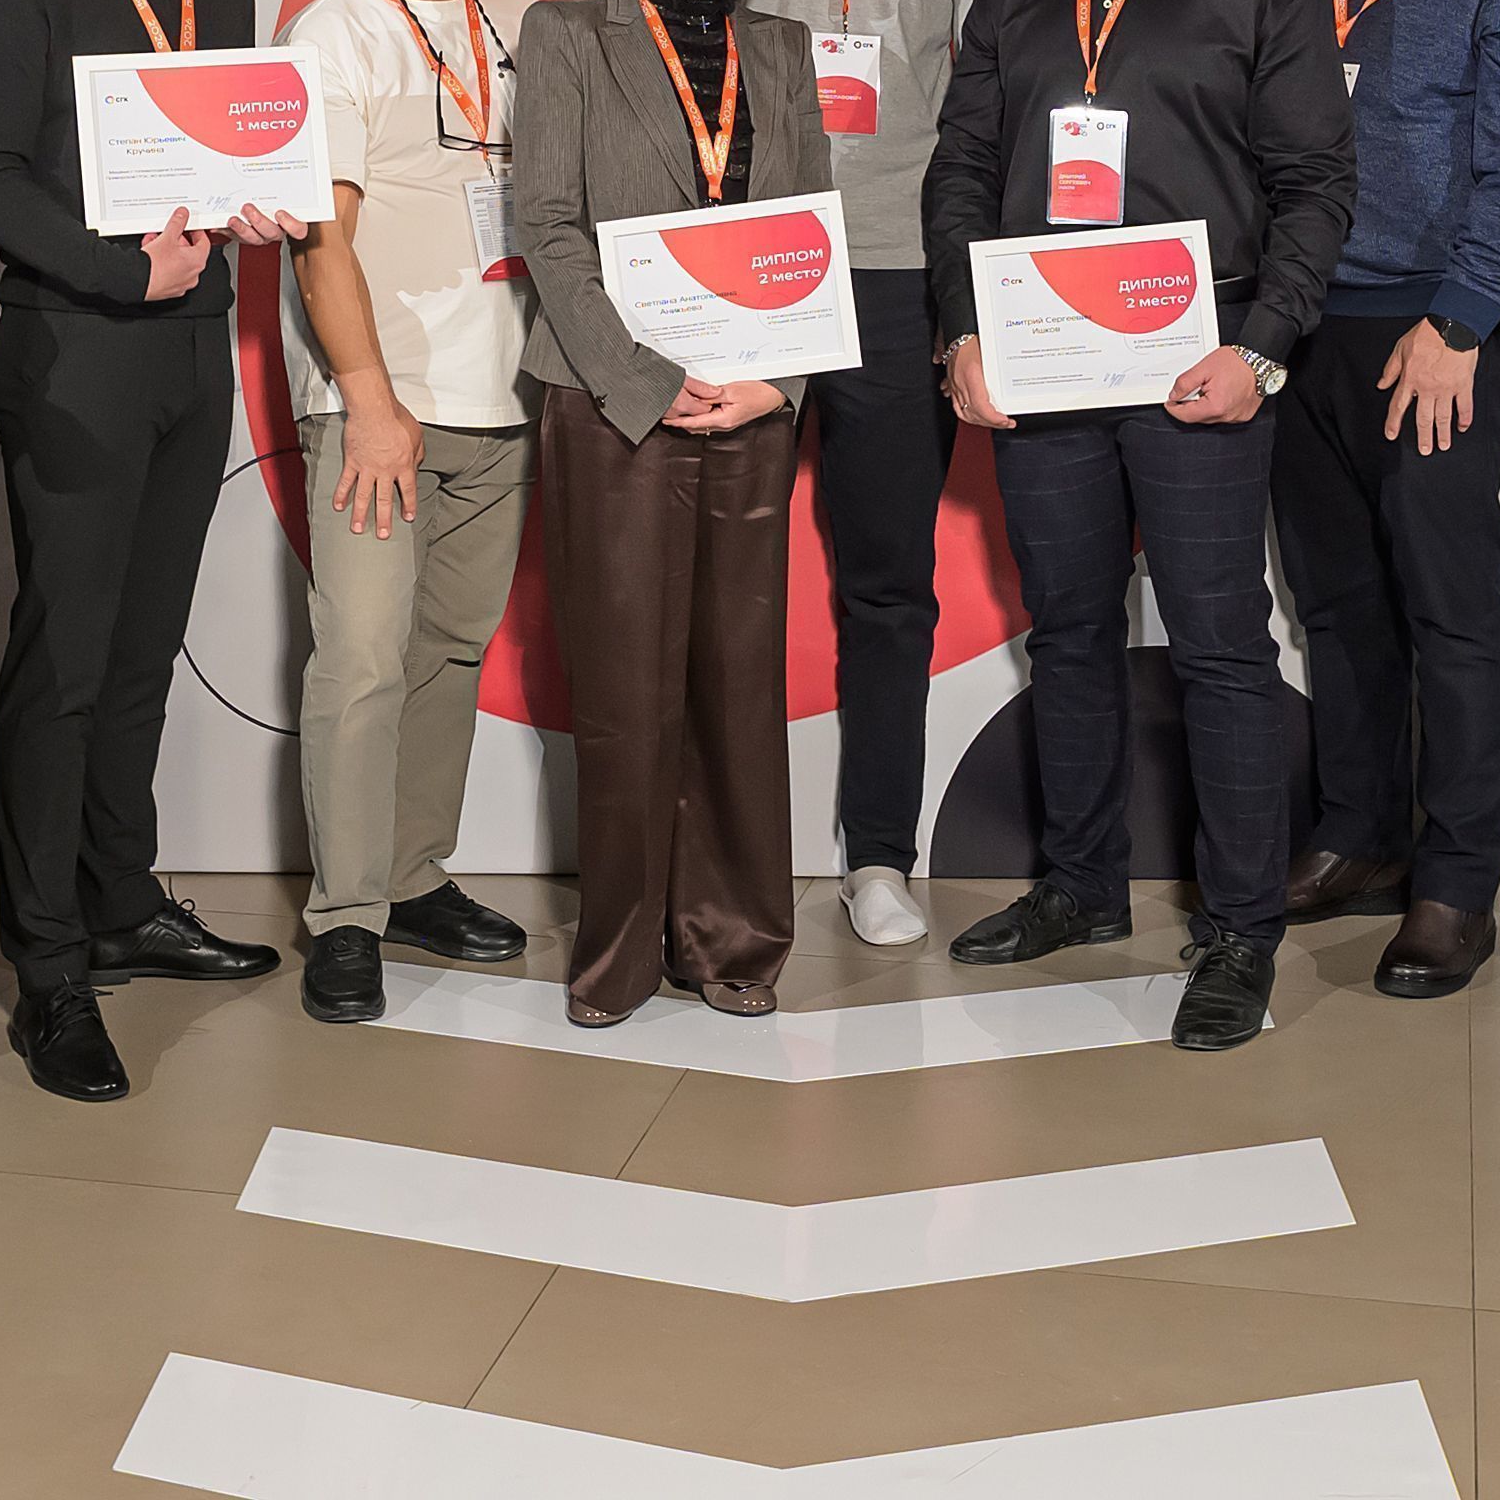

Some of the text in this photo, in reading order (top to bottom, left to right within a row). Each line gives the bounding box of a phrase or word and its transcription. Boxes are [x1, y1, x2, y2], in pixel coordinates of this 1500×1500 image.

[148, 19, 163, 50] 2026
[183, 18, 192, 47] 2026
[652, 25, 669, 50] 2026
[442, 73, 464, 99] 2026
[228, 100, 300, 116] ДИПЛОМ
[686, 100, 702, 127] 2026
[722, 98, 732, 125] 2026
[236, 119, 297, 131] 1 место
[108, 136, 186, 147] Степан Юрьевич
[751, 248, 823, 270] ДИПЛОМ
[759, 268, 821, 285] 2 место
[1119, 275, 1190, 294] ДИПЛОМ
[634, 296, 678, 309] Светлана
[1126, 295, 1188, 309] 2 место
[1005, 315, 1044, 328] Дмитрий
[1032, 326, 1061, 335] Ишков
